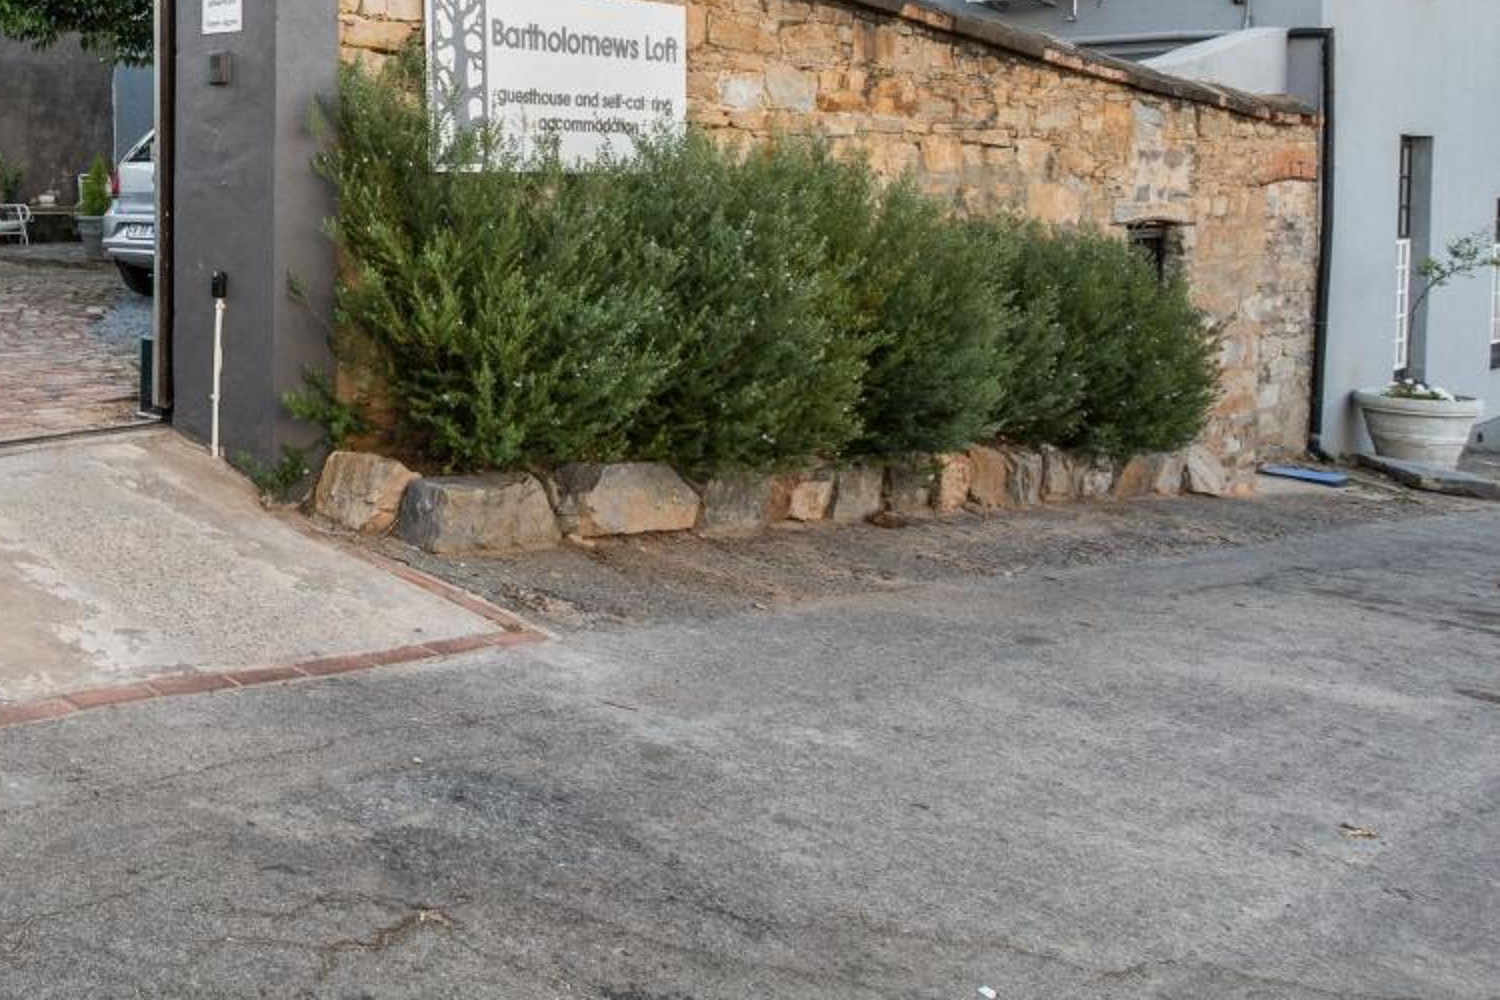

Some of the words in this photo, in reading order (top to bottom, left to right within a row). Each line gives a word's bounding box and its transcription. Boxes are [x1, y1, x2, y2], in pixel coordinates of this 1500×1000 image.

[491, 18, 639, 60] Bartholomews
[645, 35, 678, 63] Loft
[499, 89, 571, 107] guesthouse
[575, 93, 599, 108] and
[538, 117, 639, 135] accommodation
